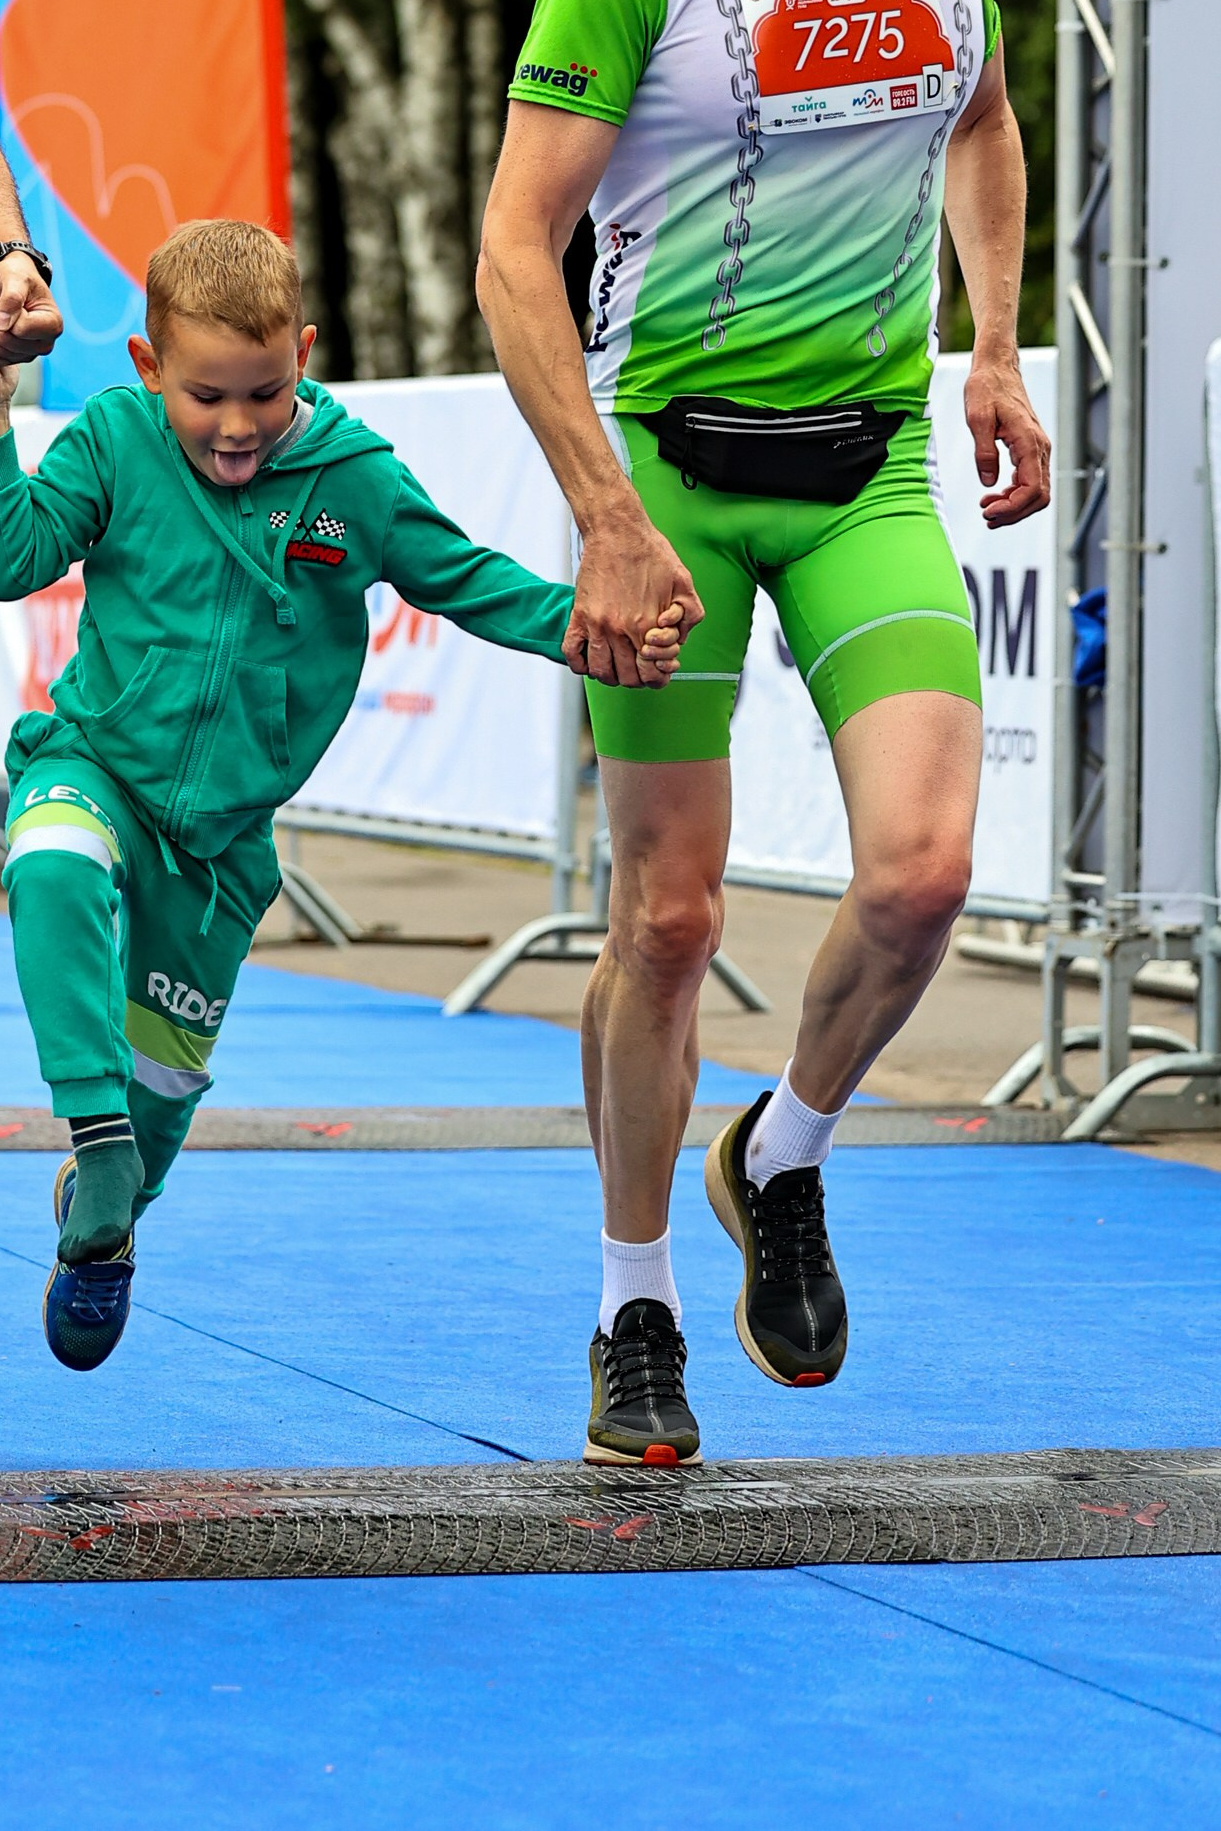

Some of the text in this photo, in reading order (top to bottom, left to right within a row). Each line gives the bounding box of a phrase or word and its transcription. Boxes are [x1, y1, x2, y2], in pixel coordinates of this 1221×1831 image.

[793, 10, 904, 71] 7275
[927, 74, 941, 99] D
[791, 96, 827, 113] тайга
[892, 95, 916, 108] 89.2 FM
[287, 542, 345, 565] ACING
[148, 972, 227, 1026] RIDE
